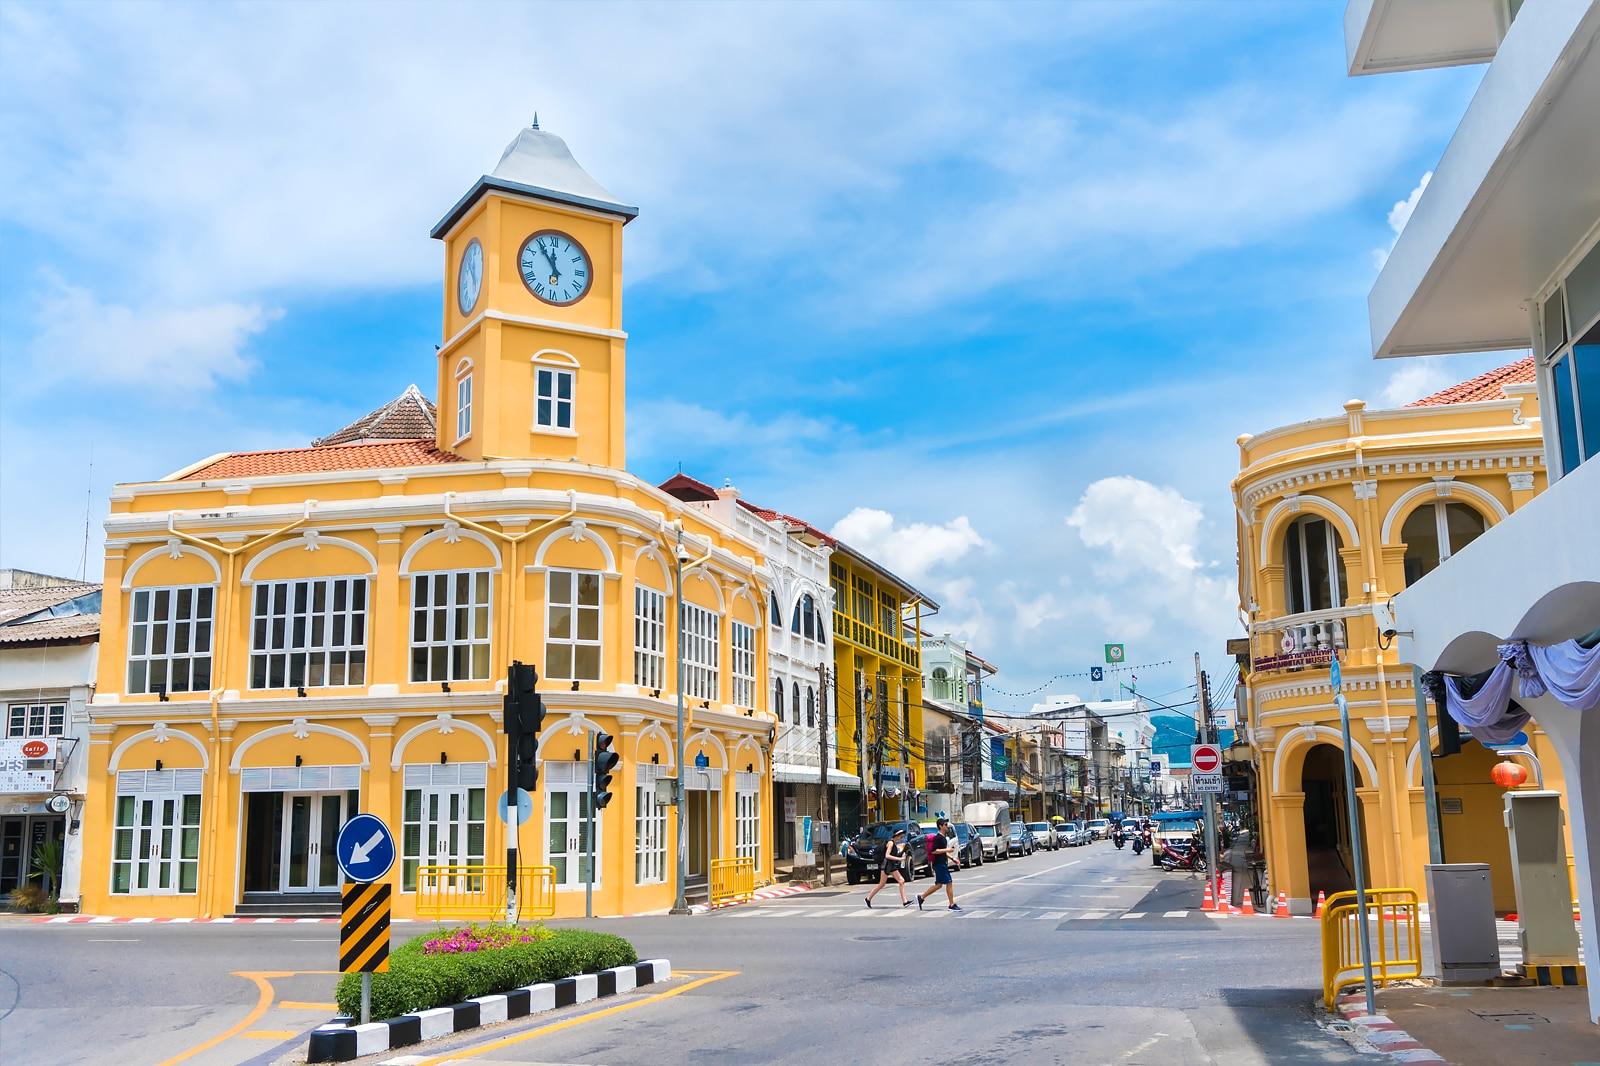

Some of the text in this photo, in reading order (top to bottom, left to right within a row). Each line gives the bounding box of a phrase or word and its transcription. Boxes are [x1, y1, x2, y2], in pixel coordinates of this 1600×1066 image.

[550, 236, 559, 248] XII
[526, 246, 536, 256] X
[564, 244, 570, 252] I
[575, 269, 584, 277] III
[534, 282, 545, 296] VII
[563, 289, 572, 300] V
[549, 289, 558, 301] VI
